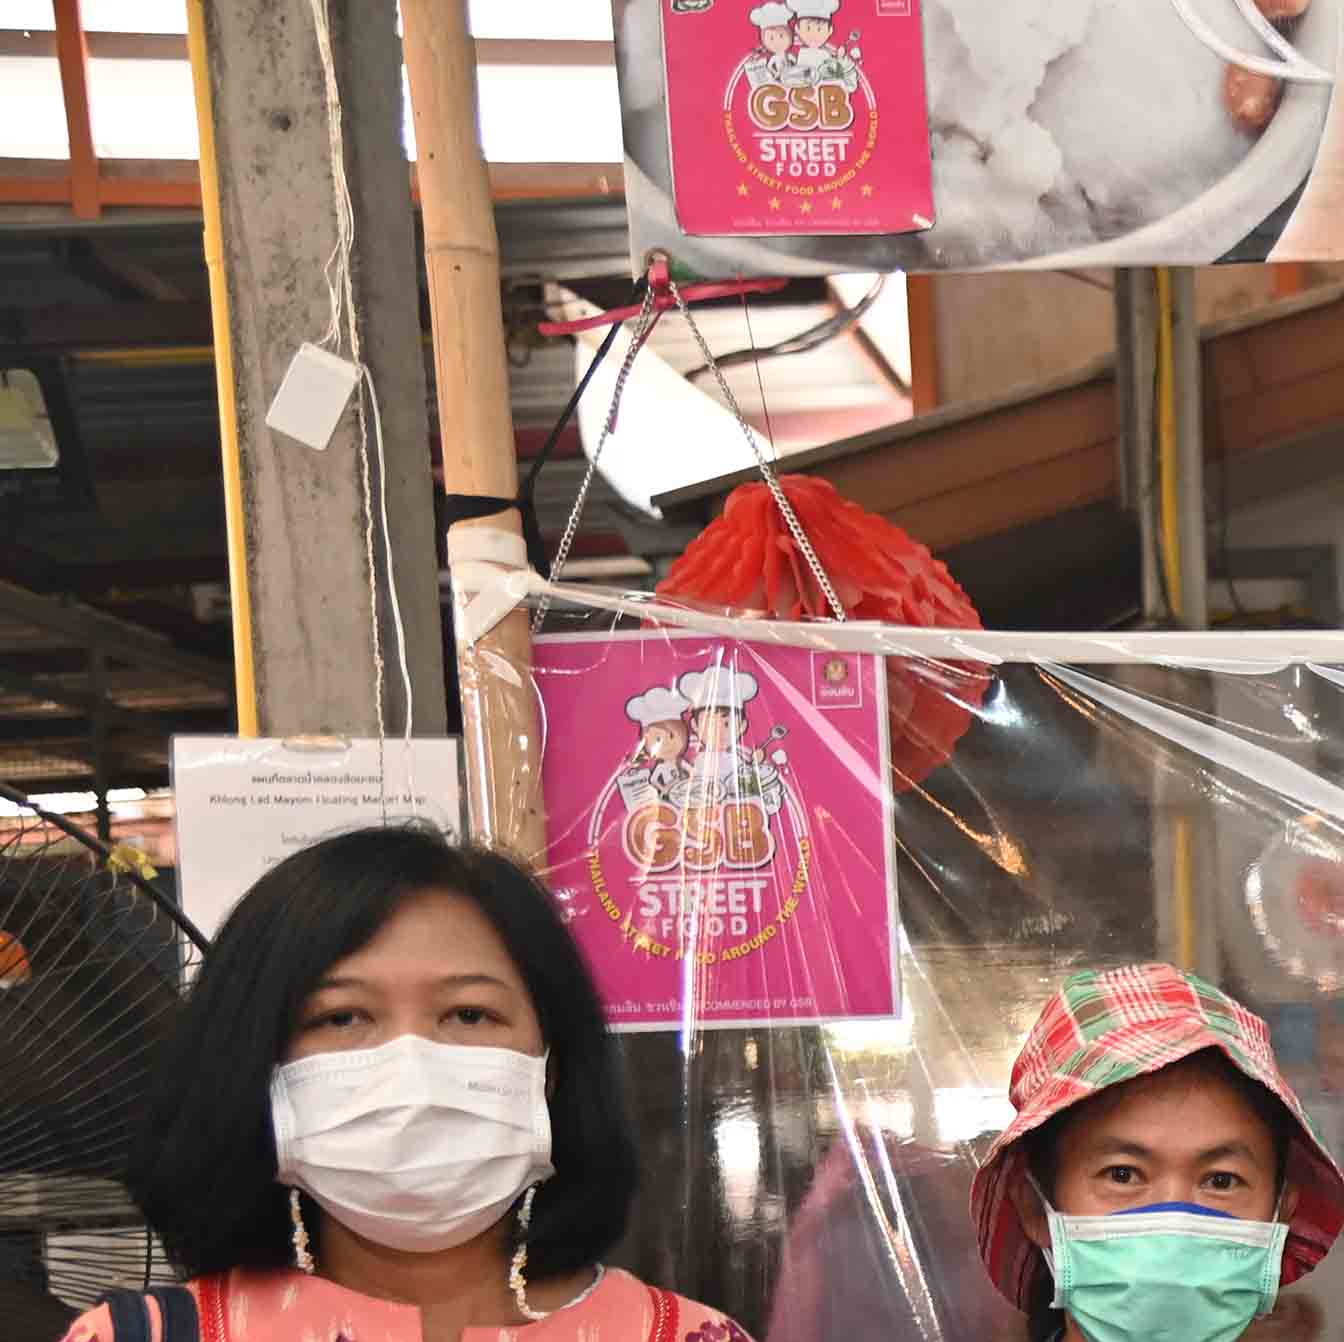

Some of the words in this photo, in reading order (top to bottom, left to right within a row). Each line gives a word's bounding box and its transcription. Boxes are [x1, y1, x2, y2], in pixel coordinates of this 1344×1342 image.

[749, 82, 854, 131] GSB
[759, 138, 849, 162] STREET
[775, 162, 837, 177] FOOD
[623, 801, 775, 871] GSB
[638, 881, 767, 917] STREET
[662, 917, 748, 938] FOOD
[722, 924, 777, 961] AROUND
